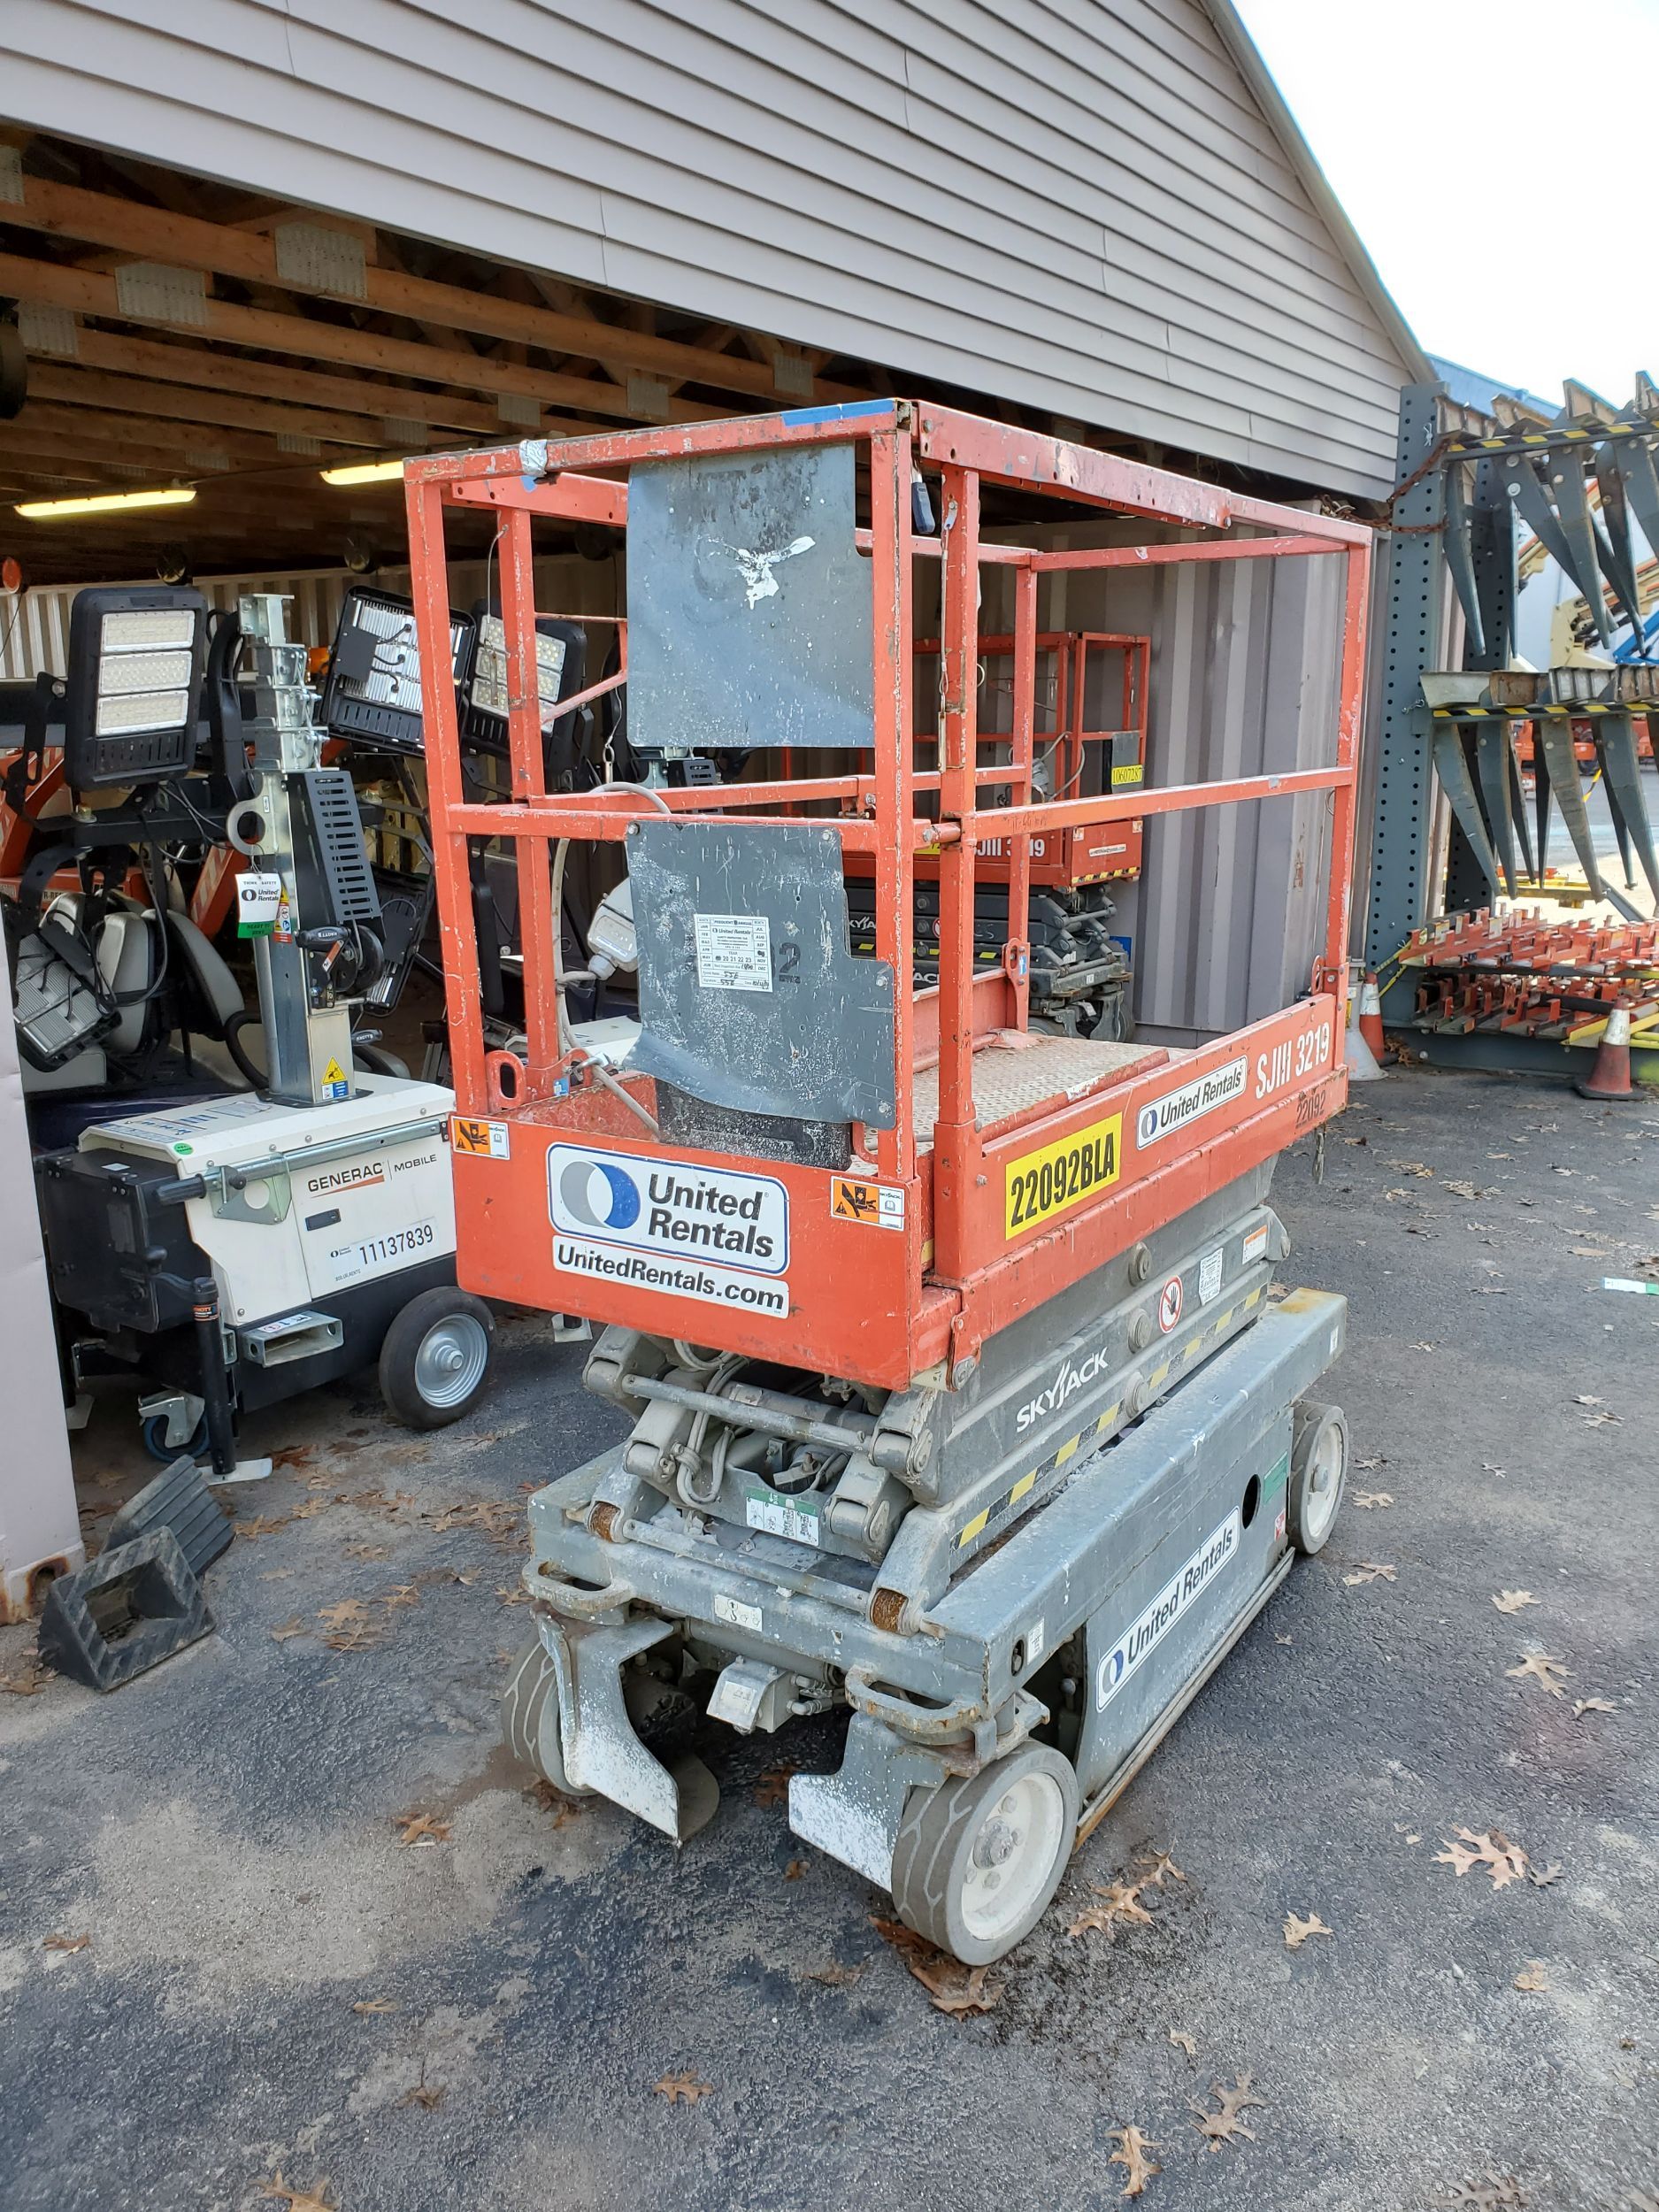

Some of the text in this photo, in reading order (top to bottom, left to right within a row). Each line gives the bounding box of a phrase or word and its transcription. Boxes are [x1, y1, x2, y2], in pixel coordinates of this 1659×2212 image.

[849, 916, 877, 930] KYJA
[1256, 1022, 1330, 1099] SJIII 3219
[1161, 1070, 1242, 1128] United Rentals
[308, 1154, 437, 1192] GENERAC MOBILE
[649, 1173, 764, 1221] United
[1011, 1133, 1115, 1228] 22092BLA
[359, 1225, 434, 1264] 11137839
[648, 1208, 774, 1258] Rentals
[557, 1244, 785, 1310] UnitedRentals.com
[1017, 1346, 1109, 1432] SKYJACK
[1128, 1528, 1233, 1664] United Rentals
